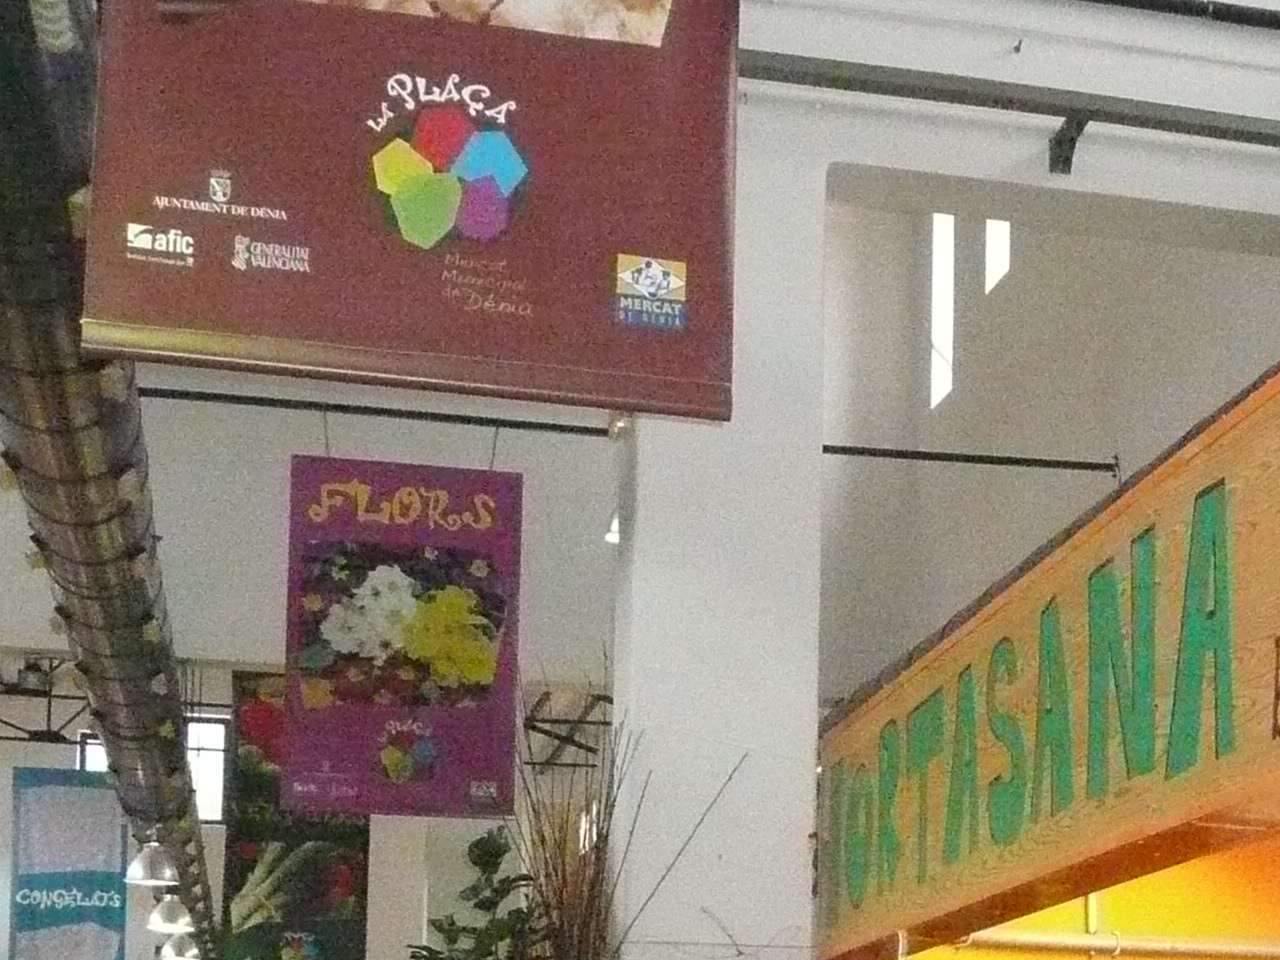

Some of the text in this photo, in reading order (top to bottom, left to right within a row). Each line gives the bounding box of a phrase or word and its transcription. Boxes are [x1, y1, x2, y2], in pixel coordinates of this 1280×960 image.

[366, 73, 516, 132] LA PLAÇA
[152, 196, 228, 214] AJUNTAMENT
[231, 206, 248, 217] DE
[154, 229, 195, 254] afic
[250, 241, 310, 261] GENERALITAT
[250, 256, 311, 273] VALENCIANA
[620, 296, 682, 316] MERCAT
[308, 480, 496, 530] FLORS
